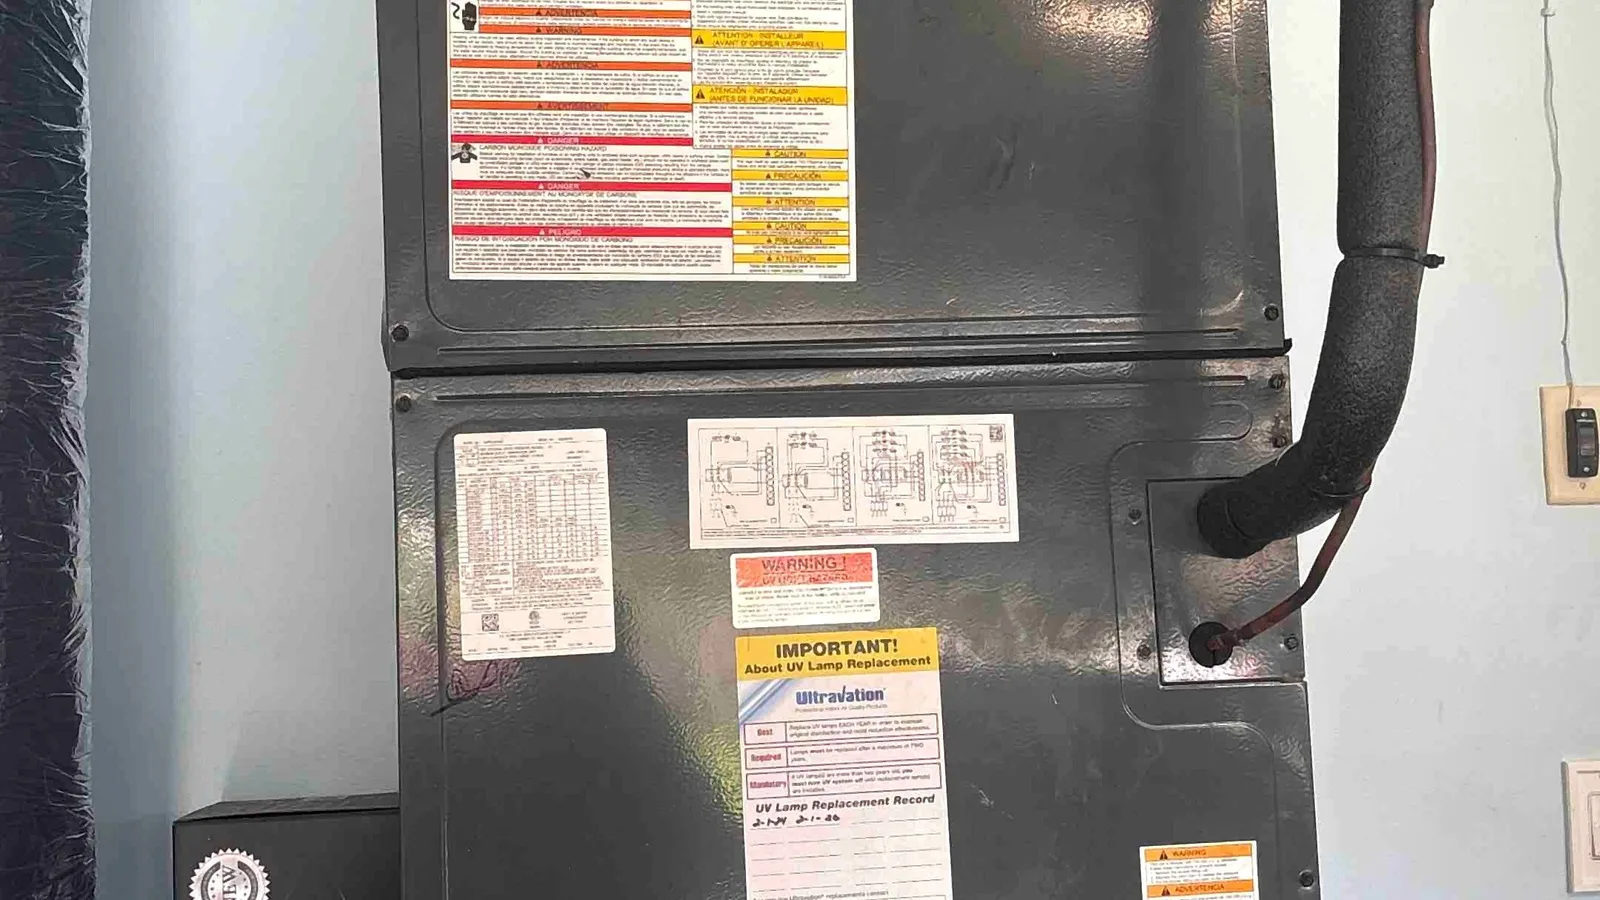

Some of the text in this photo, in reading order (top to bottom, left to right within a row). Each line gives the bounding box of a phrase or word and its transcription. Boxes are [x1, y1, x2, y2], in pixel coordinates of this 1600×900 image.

[761, 557, 837, 571] WARNING
[776, 639, 898, 658] IMPORTANT!
[745, 656, 931, 675] About UV Lamp Replacement
[796, 684, 885, 705] Ultravation
[755, 794, 935, 813] UV Lamp Replacement Record
